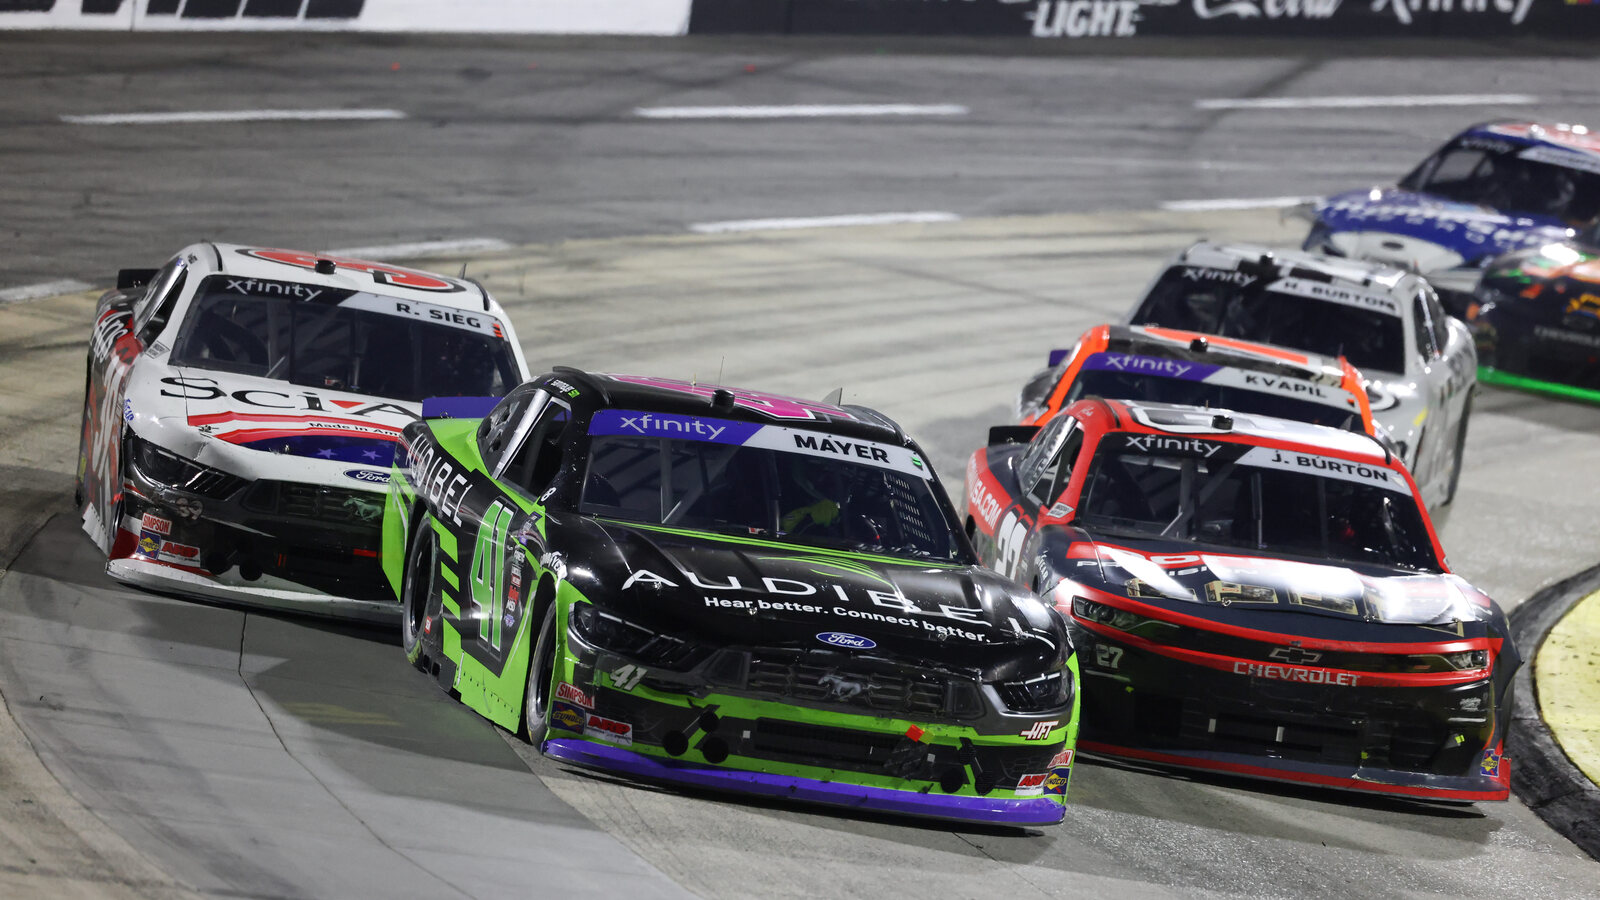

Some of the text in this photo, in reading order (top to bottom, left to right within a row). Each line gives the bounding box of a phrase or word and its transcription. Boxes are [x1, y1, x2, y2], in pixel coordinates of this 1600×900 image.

[226, 279, 322, 301] xfinity
[396, 303, 481, 329] R. SIEG
[1105, 354, 1192, 377] xfinity
[1245, 374, 1328, 399] KVAPIL
[309, 422, 350, 430] Made
[620, 413, 726, 440] xfinity
[793, 434, 890, 464] MAYER
[1125, 434, 1222, 458] xfinity
[1271, 451, 1389, 482] J. BURTON
[143, 514, 170, 533] SIMPSON
[161, 541, 199, 558] ARP
[470, 499, 516, 652] 41
[621, 569, 1056, 650] AUDIBEL
[704, 597, 992, 644] Hear better. Connect better.
[825, 632, 868, 648] Ford
[1095, 644, 1124, 669] 27
[609, 664, 649, 692] 41
[1233, 661, 1362, 687] CHEVROLET
[587, 715, 631, 735] ARP
